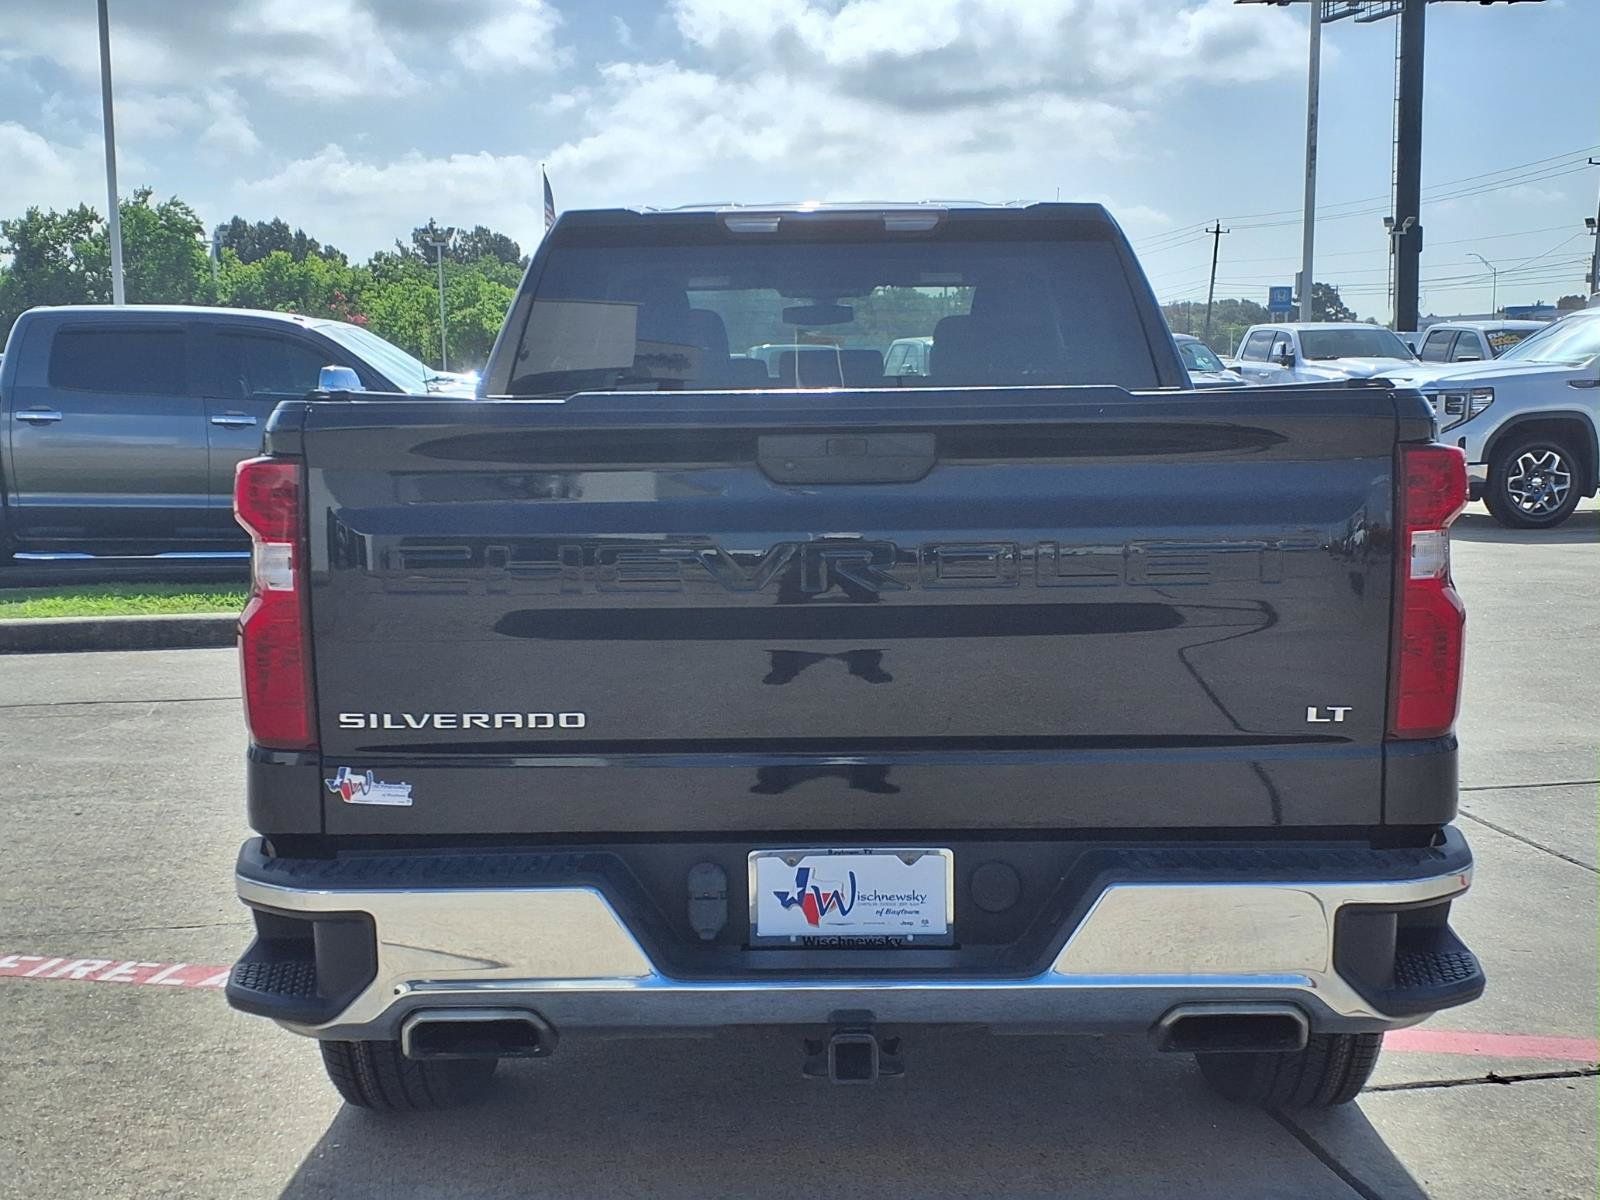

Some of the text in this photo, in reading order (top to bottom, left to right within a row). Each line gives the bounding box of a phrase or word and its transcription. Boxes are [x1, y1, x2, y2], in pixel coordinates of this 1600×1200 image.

[383, 537, 1319, 596] CHEVROLET
[338, 712, 586, 729] SILVERADO
[1307, 706, 1353, 722] LT
[811, 871, 927, 917] Wischnewsky
[875, 908, 884, 917] of
[803, 935, 903, 948] Wischnewsky
